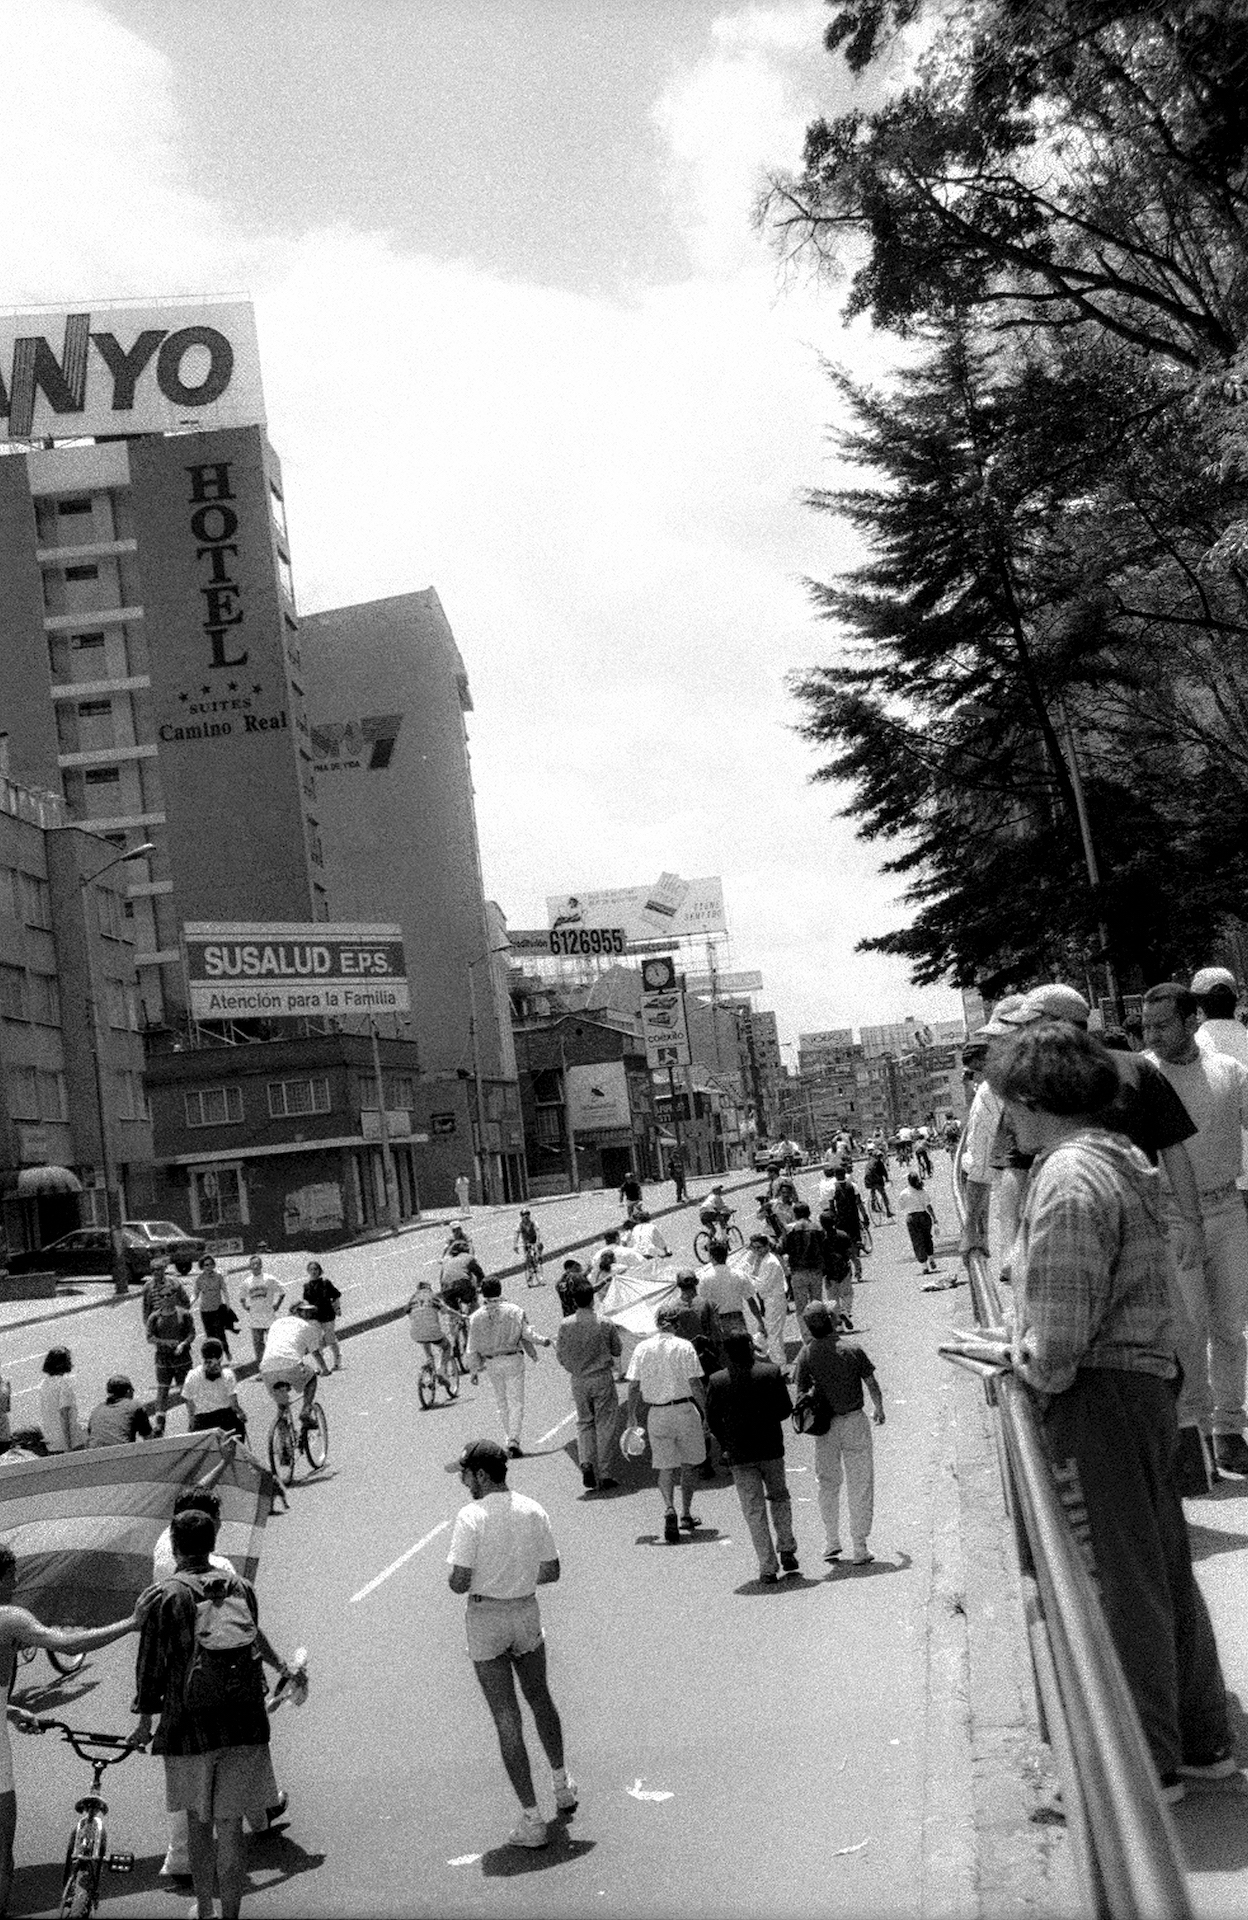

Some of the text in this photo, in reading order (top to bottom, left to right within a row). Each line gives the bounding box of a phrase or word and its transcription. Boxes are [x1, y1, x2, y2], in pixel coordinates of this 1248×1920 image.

[185, 462, 249, 669] HOTEL
[189, 698, 252, 715] SUITES
[159, 710, 287, 741] Camino Real
[549, 929, 624, 955] 6126955
[204, 946, 331, 975] SUSALUD
[210, 990, 396, 1011] Atención para la Familia
